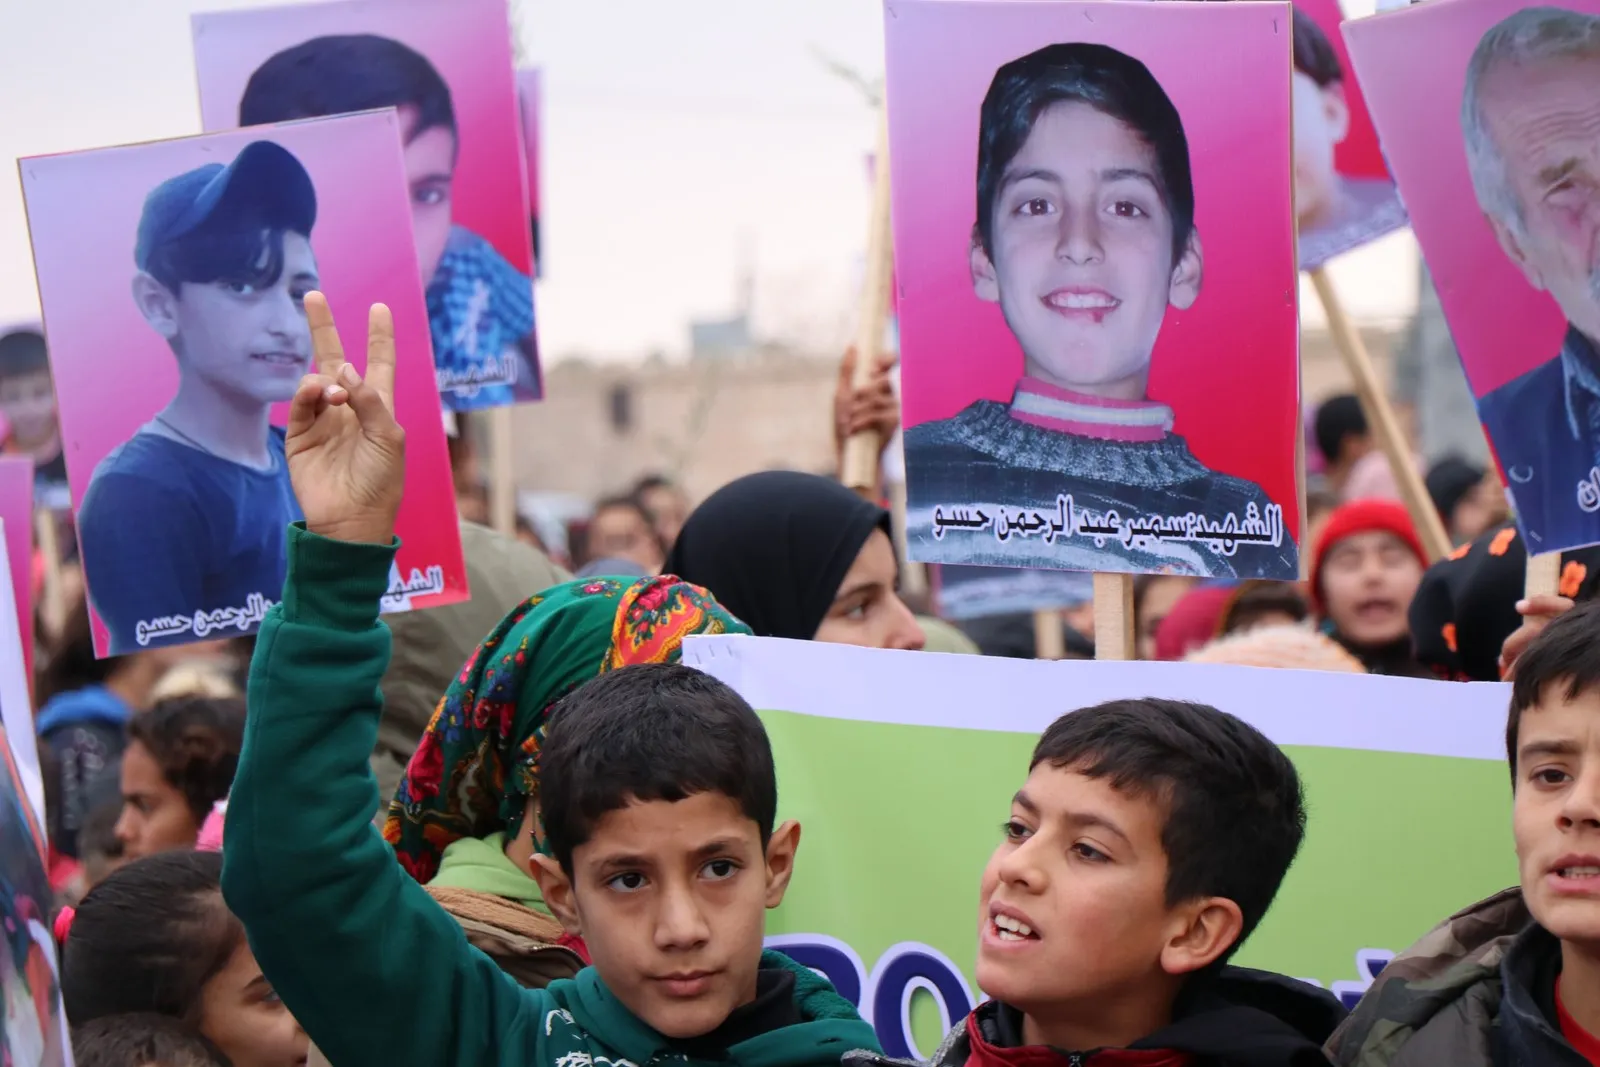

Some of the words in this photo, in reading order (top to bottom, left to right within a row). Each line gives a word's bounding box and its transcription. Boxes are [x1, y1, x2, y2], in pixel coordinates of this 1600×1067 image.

[932, 504, 992, 541] حسو
[995, 494, 1073, 545] الرحمن
[1078, 509, 1121, 547] عبد
[136, 614, 193, 646] حسو
[193, 592, 264, 637] الرحمن
